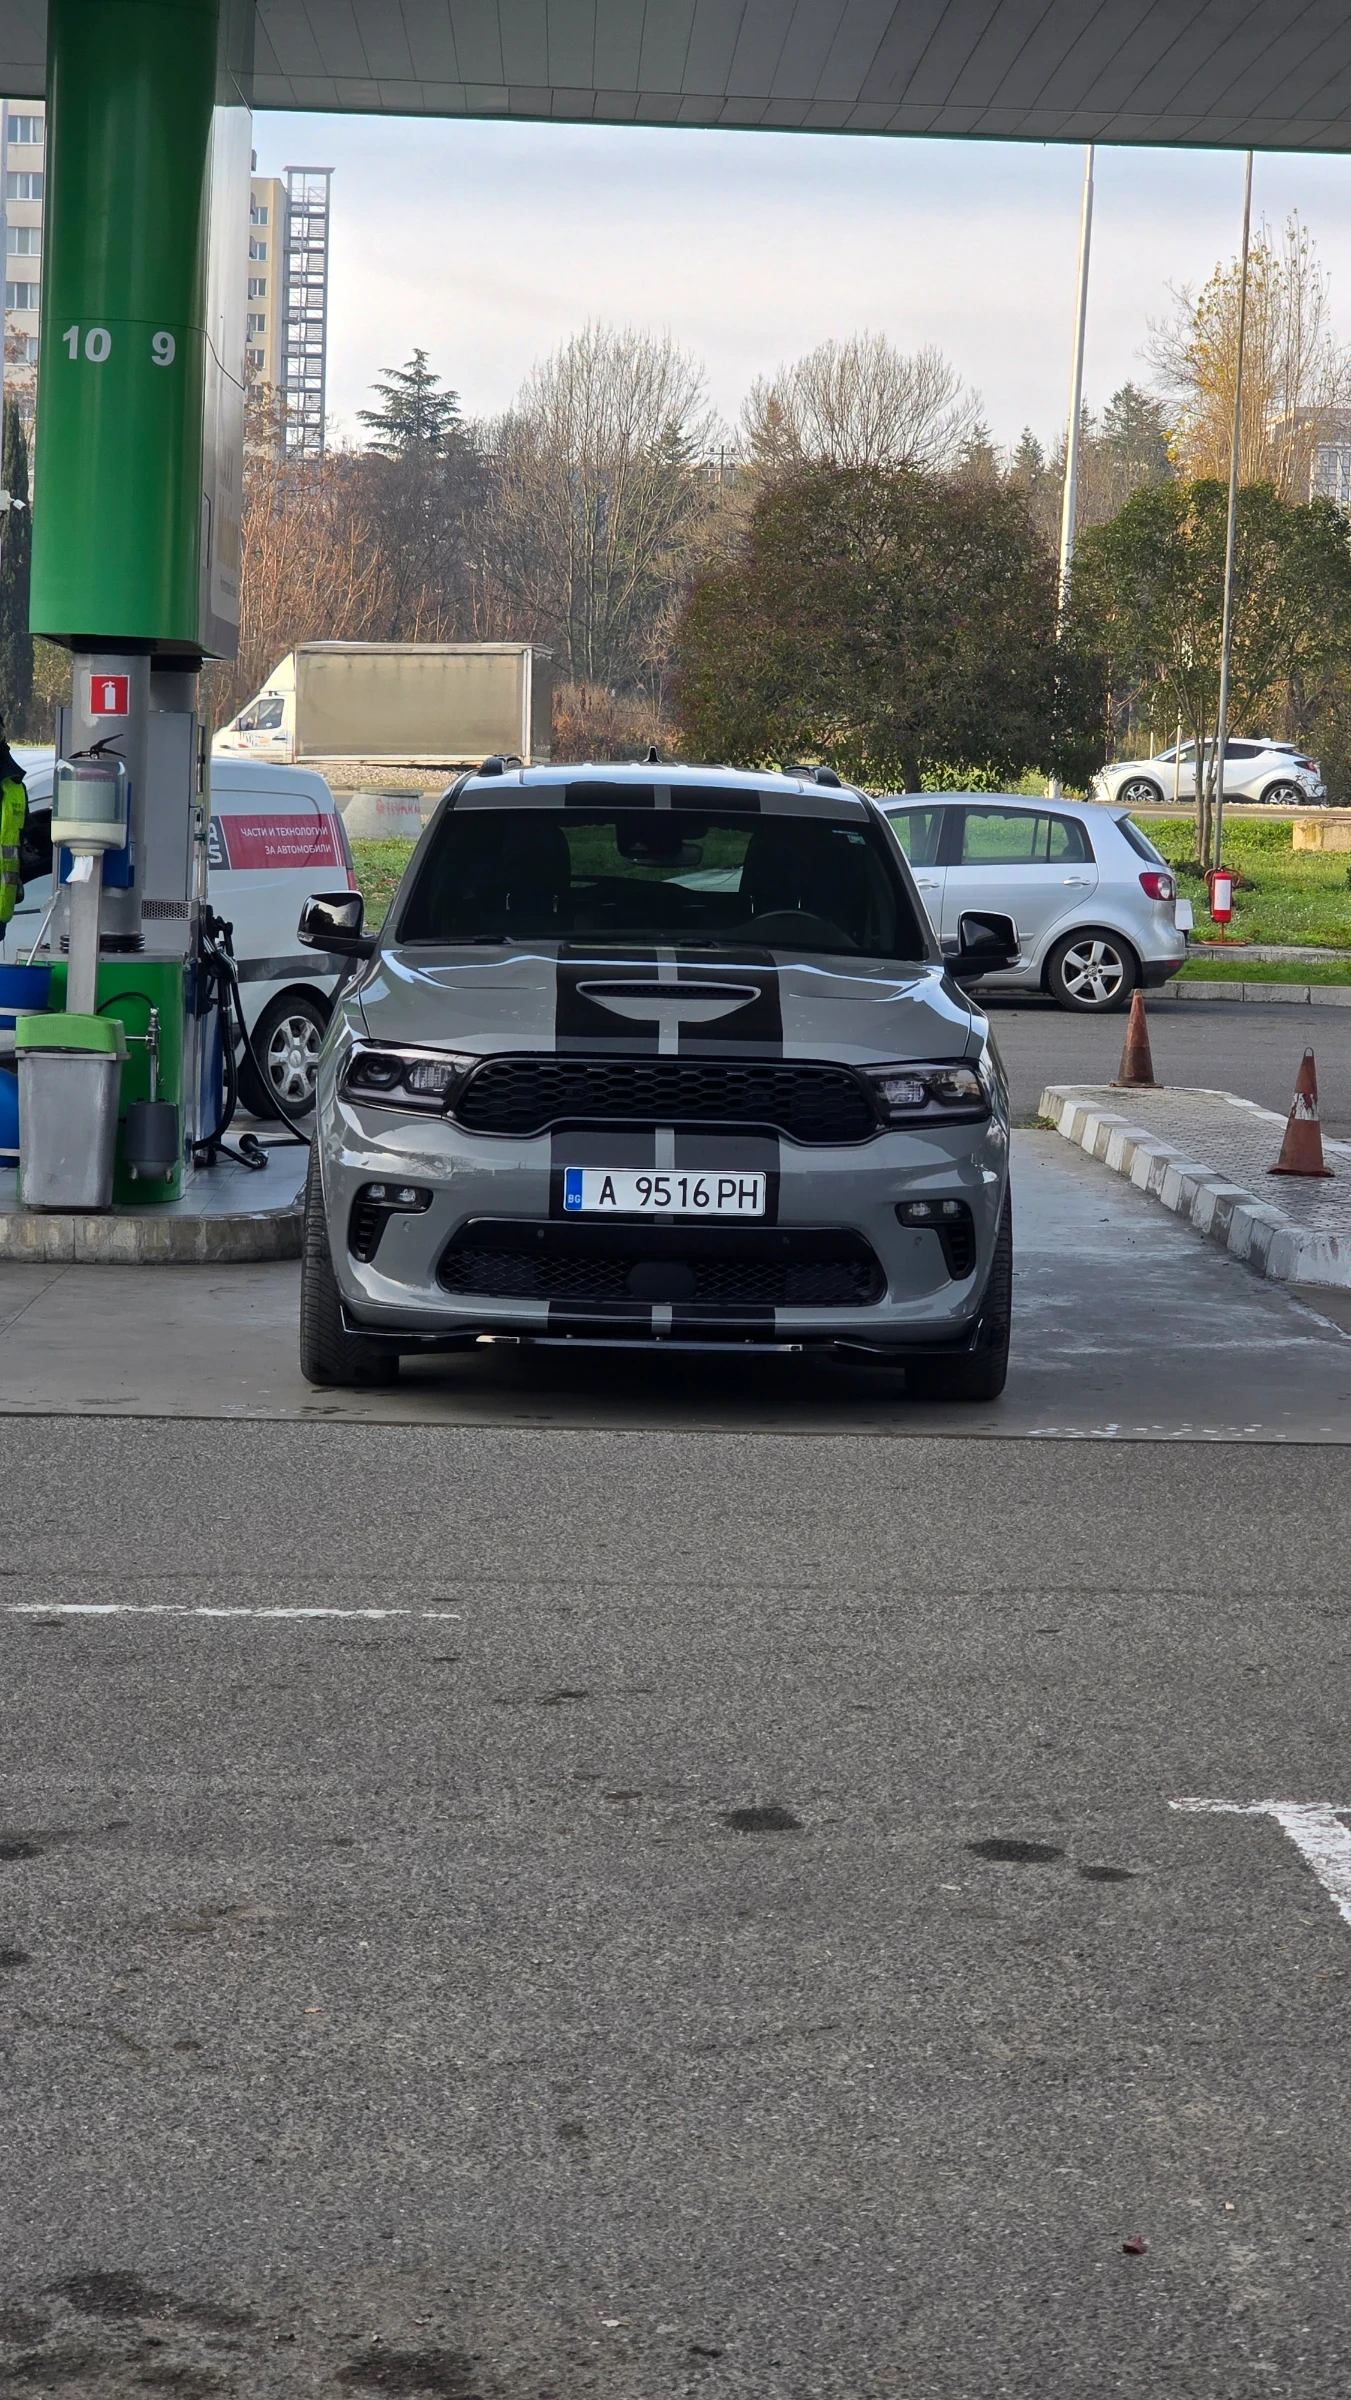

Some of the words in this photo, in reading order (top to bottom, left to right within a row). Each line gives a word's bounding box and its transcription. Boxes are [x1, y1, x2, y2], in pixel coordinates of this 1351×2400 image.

[62, 325, 112, 362] 10
[151, 331, 176, 366] 9
[240, 827, 267, 837] ЧАСТИ
[269, 827, 276, 836] И
[276, 826, 328, 836] ТЕХНОЛОГИИ
[265, 845, 276, 855] ЗА
[276, 844, 331, 855] АВТОМОБИЛИ
[599, 1175, 617, 1206] A
[635, 1176, 710, 1208] 9516
[717, 1178, 758, 1209] PH
[568, 1194, 581, 1204] BG
